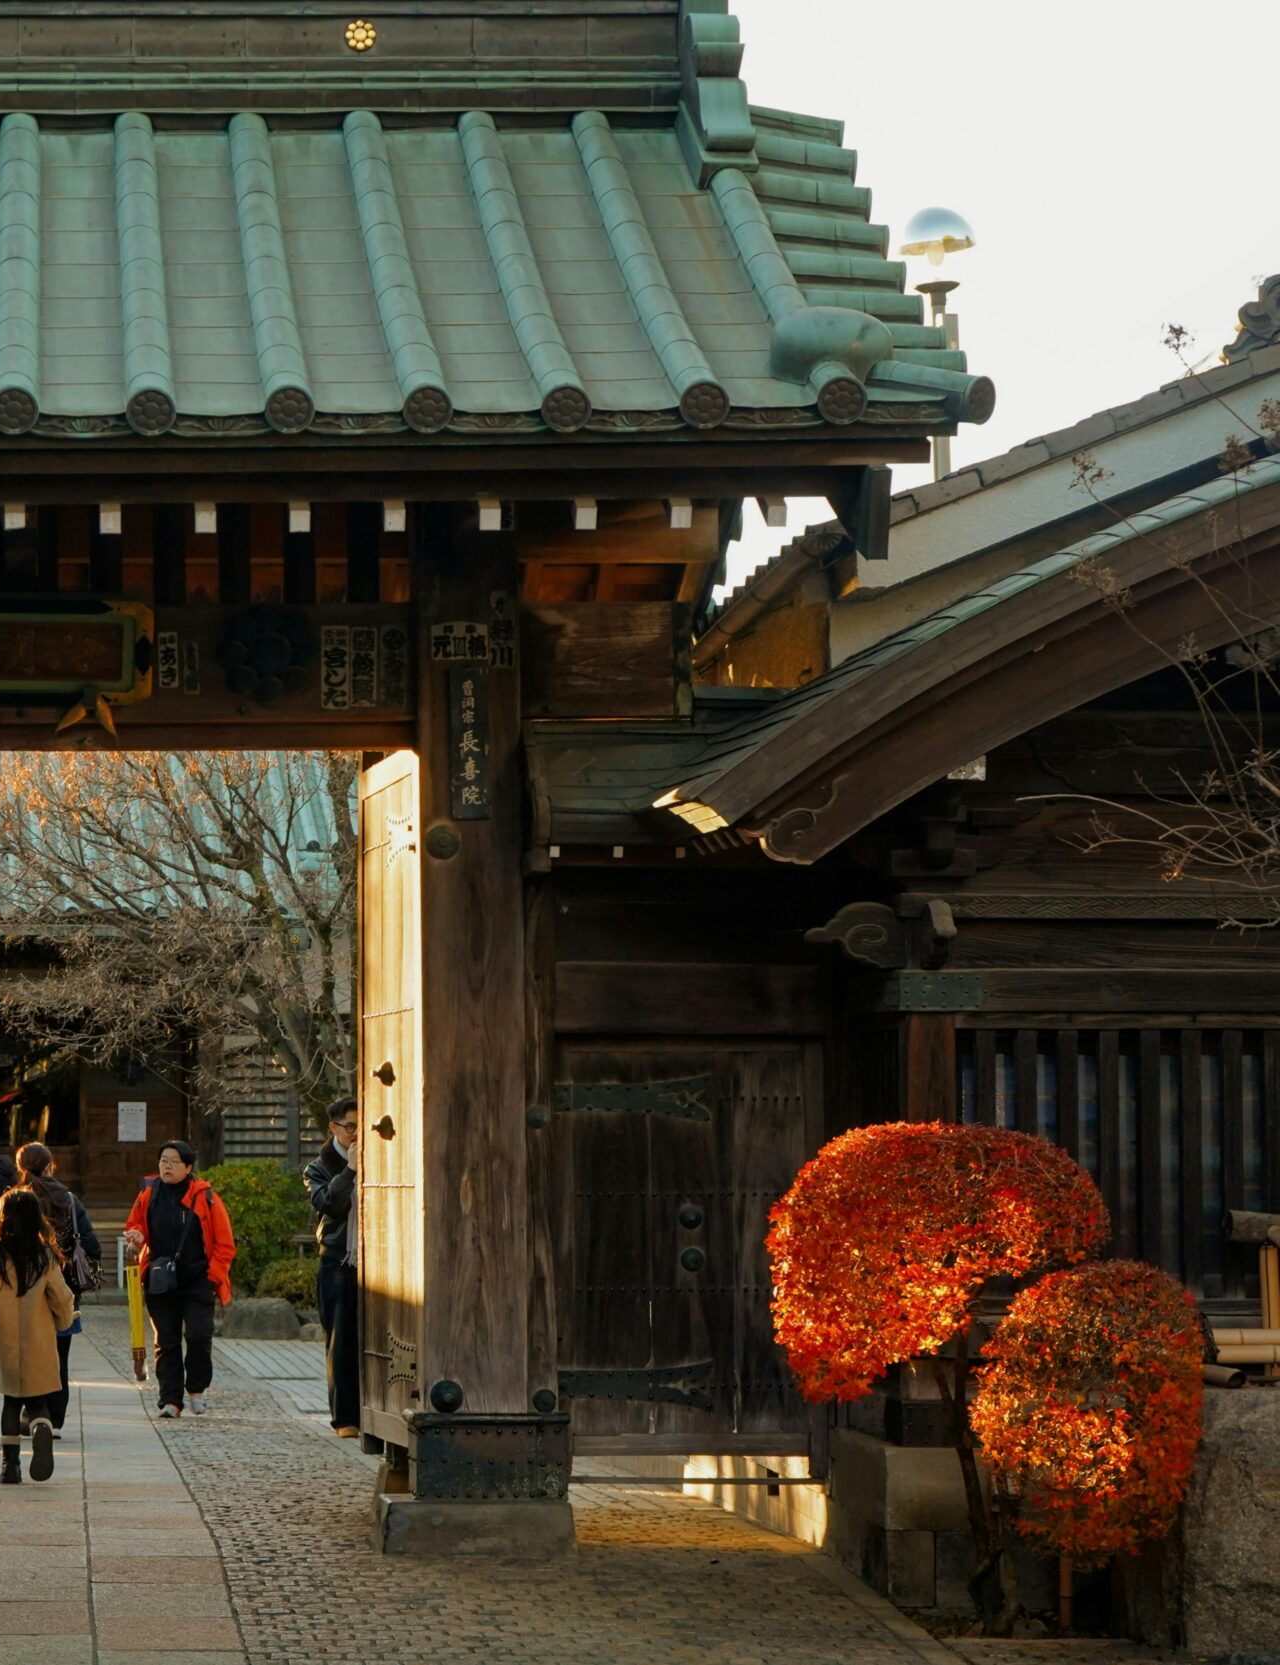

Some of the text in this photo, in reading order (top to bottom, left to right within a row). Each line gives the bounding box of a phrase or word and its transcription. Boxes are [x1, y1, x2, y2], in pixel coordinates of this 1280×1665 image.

[323, 646, 347, 708] 宮した
[458, 679, 483, 806] 曹洞宗 長喜院
